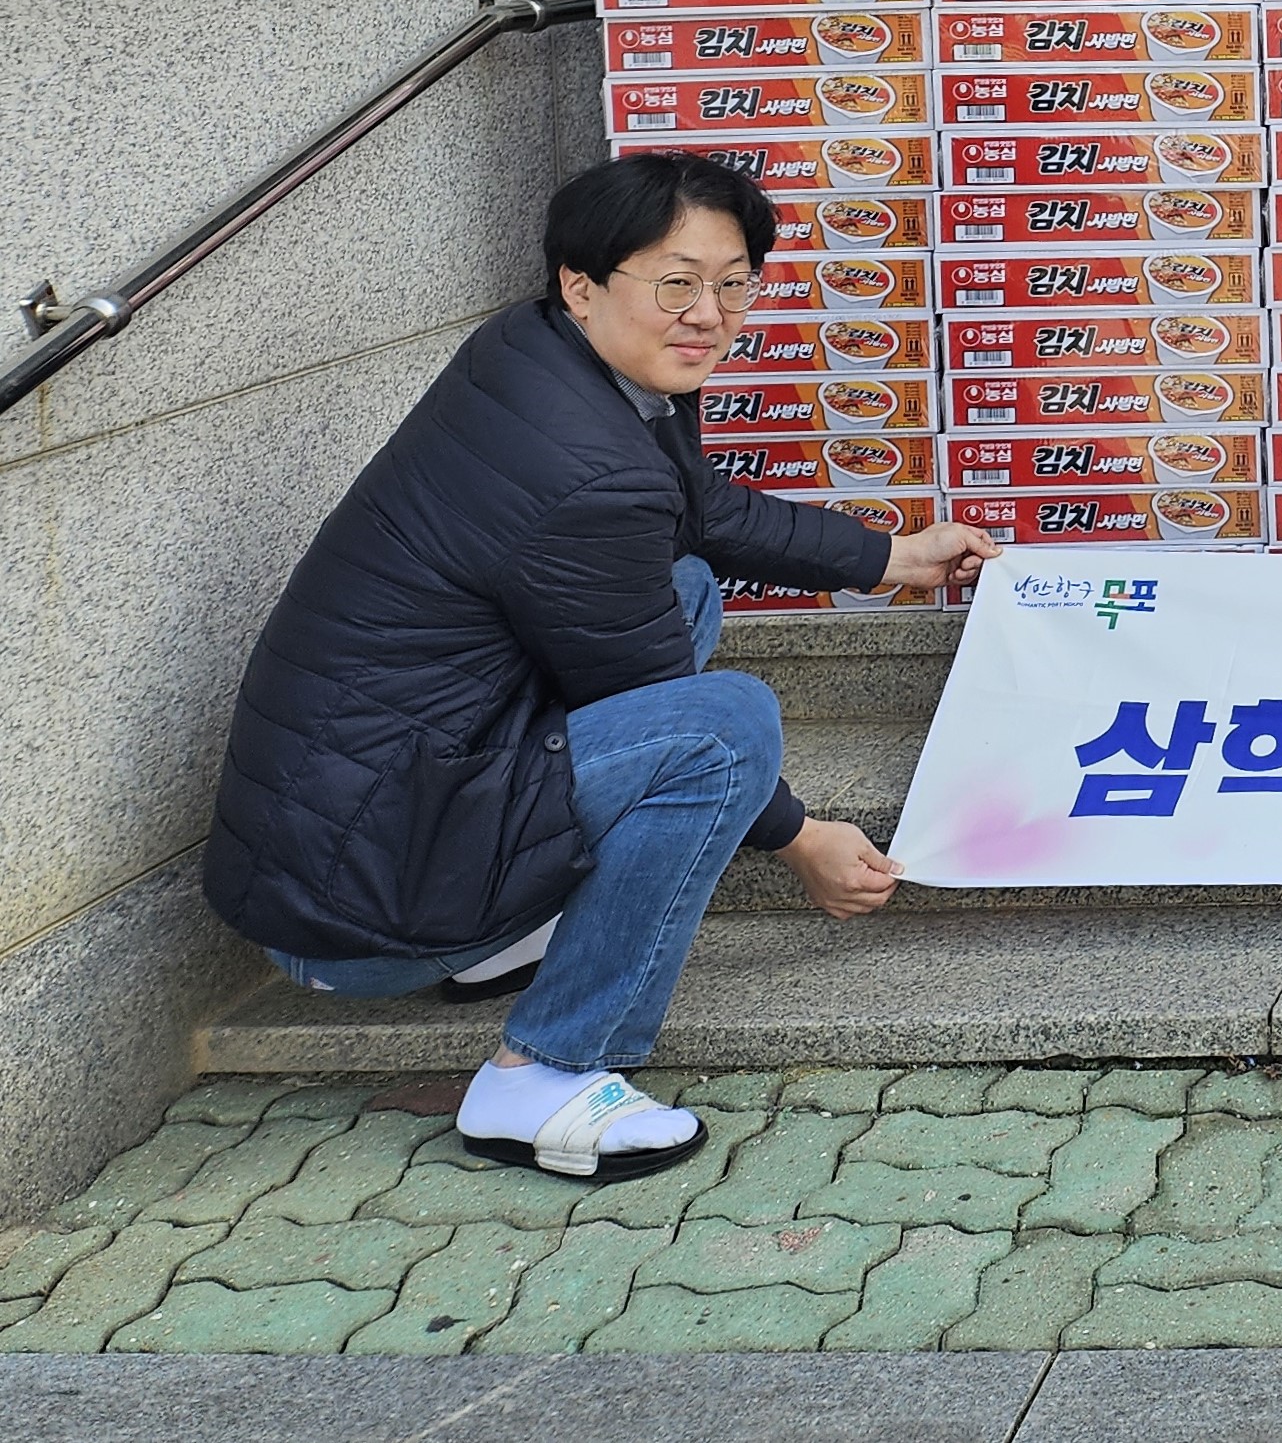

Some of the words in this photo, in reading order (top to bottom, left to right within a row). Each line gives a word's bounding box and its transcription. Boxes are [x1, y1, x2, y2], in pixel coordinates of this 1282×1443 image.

[644, 93, 678, 107] 농심
[697, 87, 762, 120] 김치
[758, 98, 813, 116] 사발면
[973, 270, 1007, 284] 농심
[1025, 264, 1090, 297] 김치
[1086, 276, 1141, 294] 사발면
[1094, 580, 1158, 630] 목포
